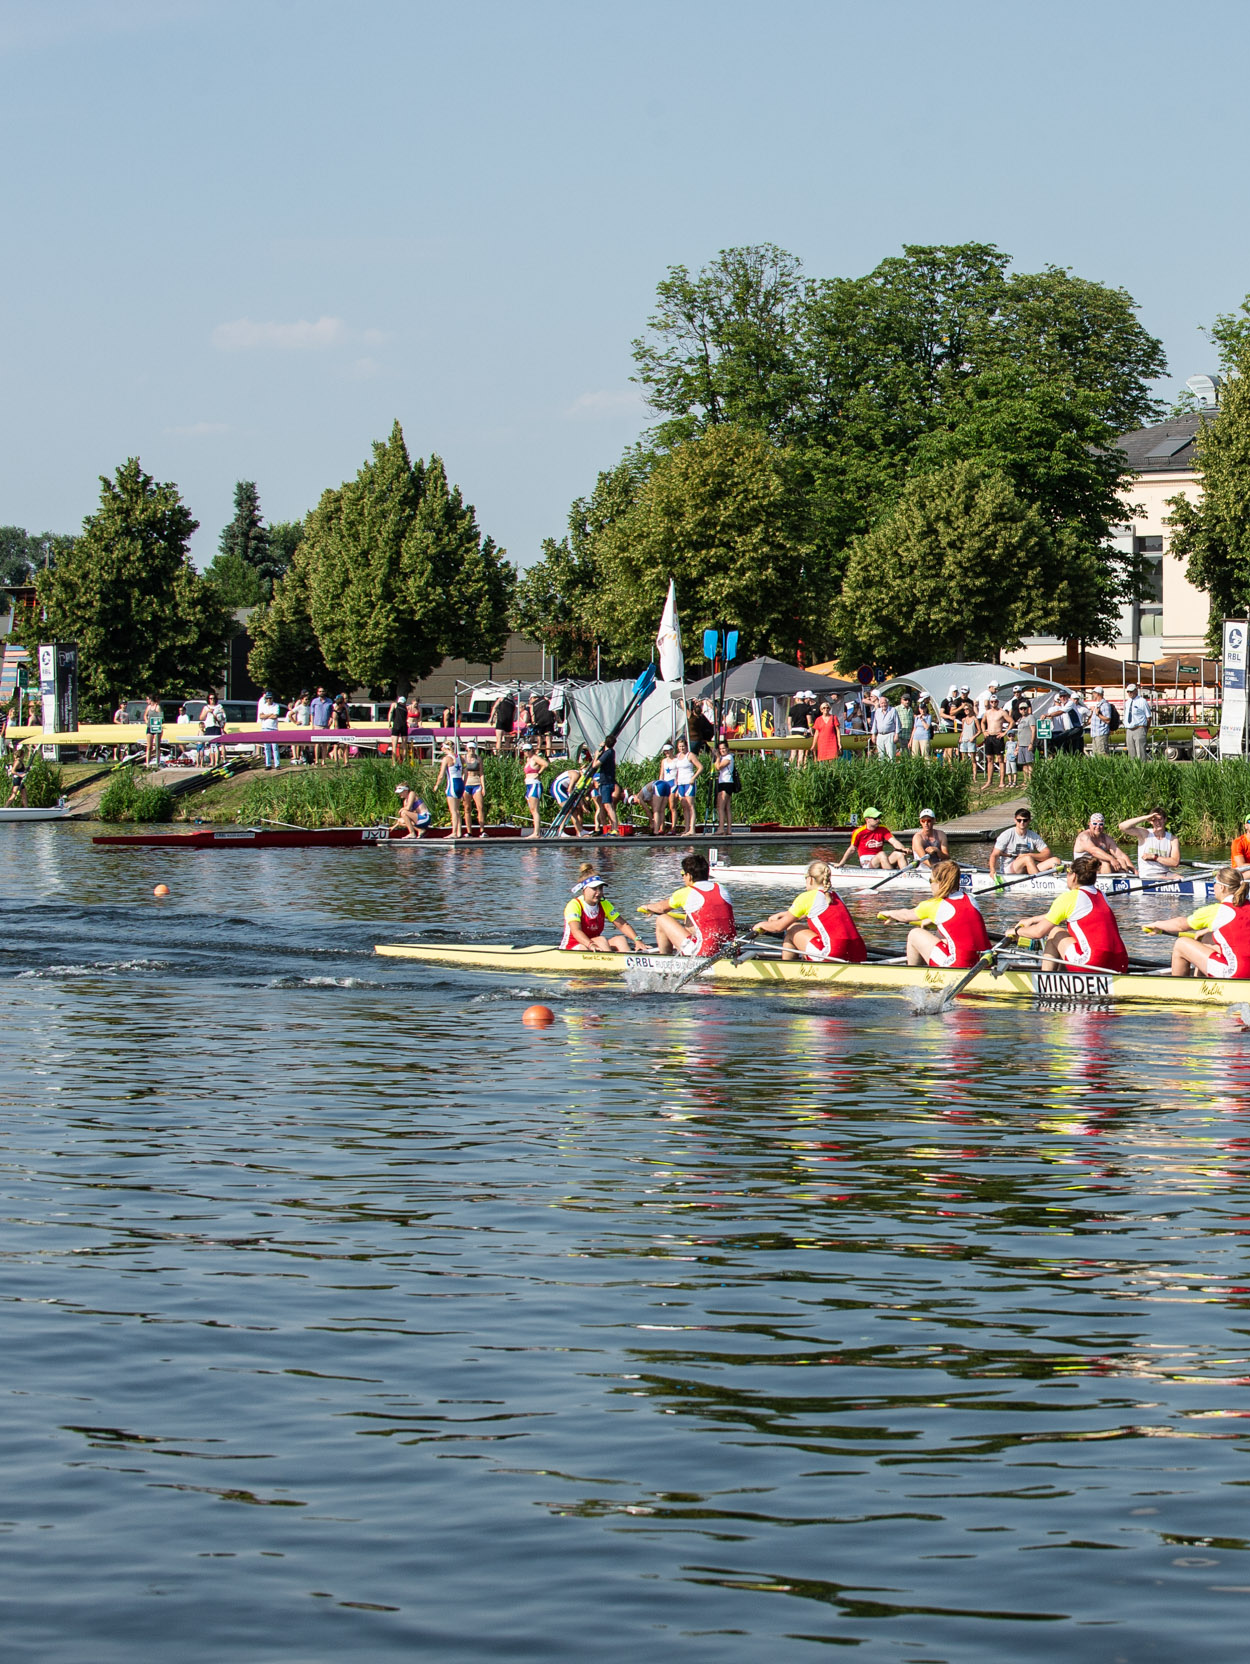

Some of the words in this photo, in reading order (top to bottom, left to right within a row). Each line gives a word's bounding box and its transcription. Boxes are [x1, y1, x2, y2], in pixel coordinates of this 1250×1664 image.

[1031, 879, 1056, 889] Strom
[636, 957, 654, 968] RBL
[1037, 974, 1109, 995] MINDEN
